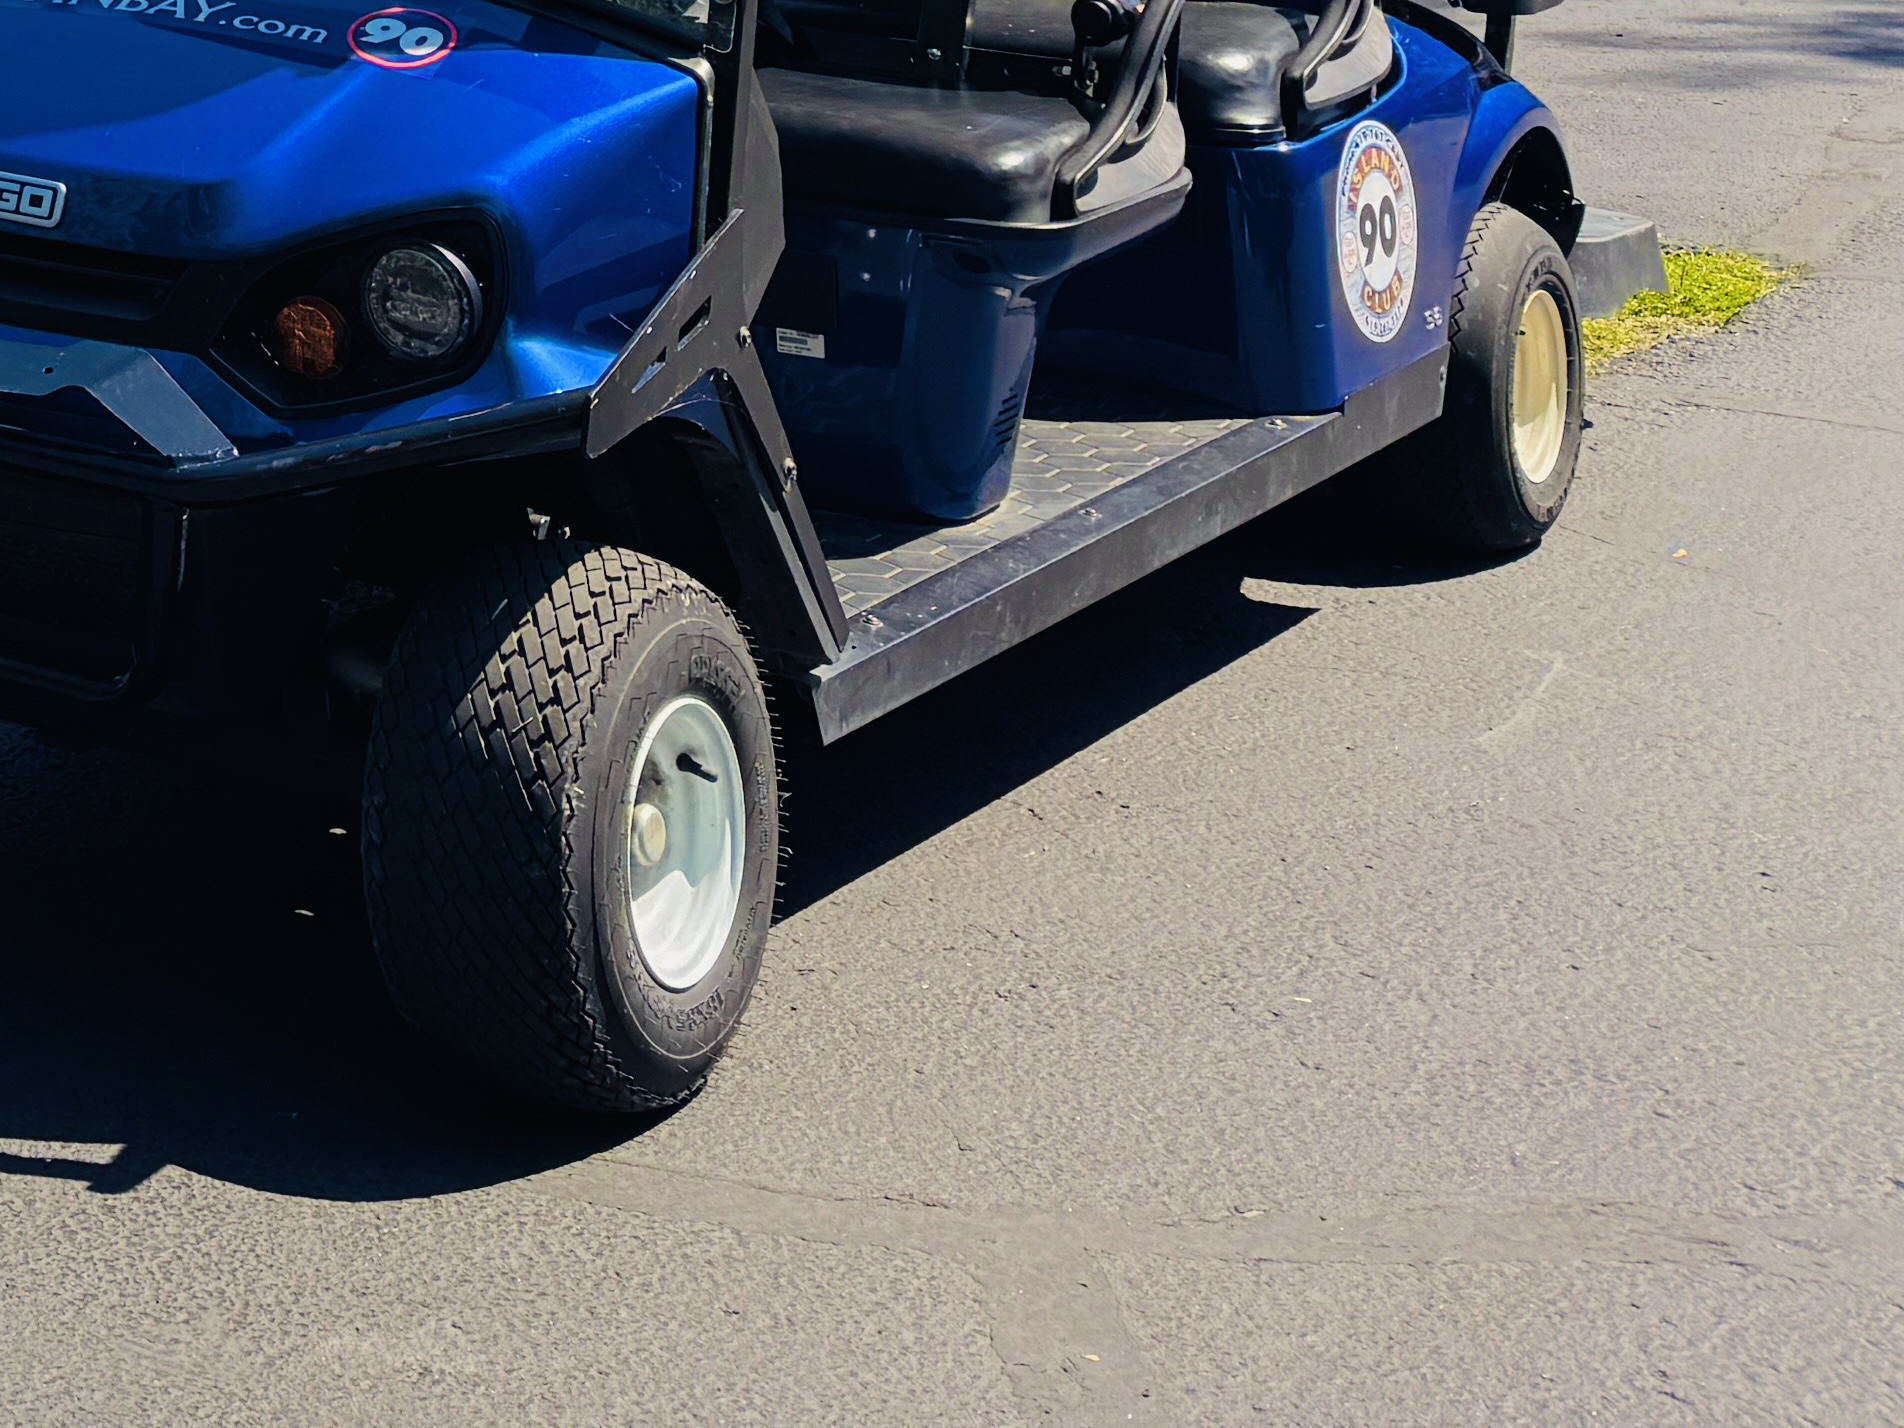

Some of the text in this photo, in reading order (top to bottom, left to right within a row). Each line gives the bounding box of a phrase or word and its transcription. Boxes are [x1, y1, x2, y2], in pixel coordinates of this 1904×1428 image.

[359, 17, 444, 56] 90
[1349, 148, 1400, 206] ISLAND
[1359, 195, 1396, 267] 90
[1363, 275, 1401, 314] CLUB
